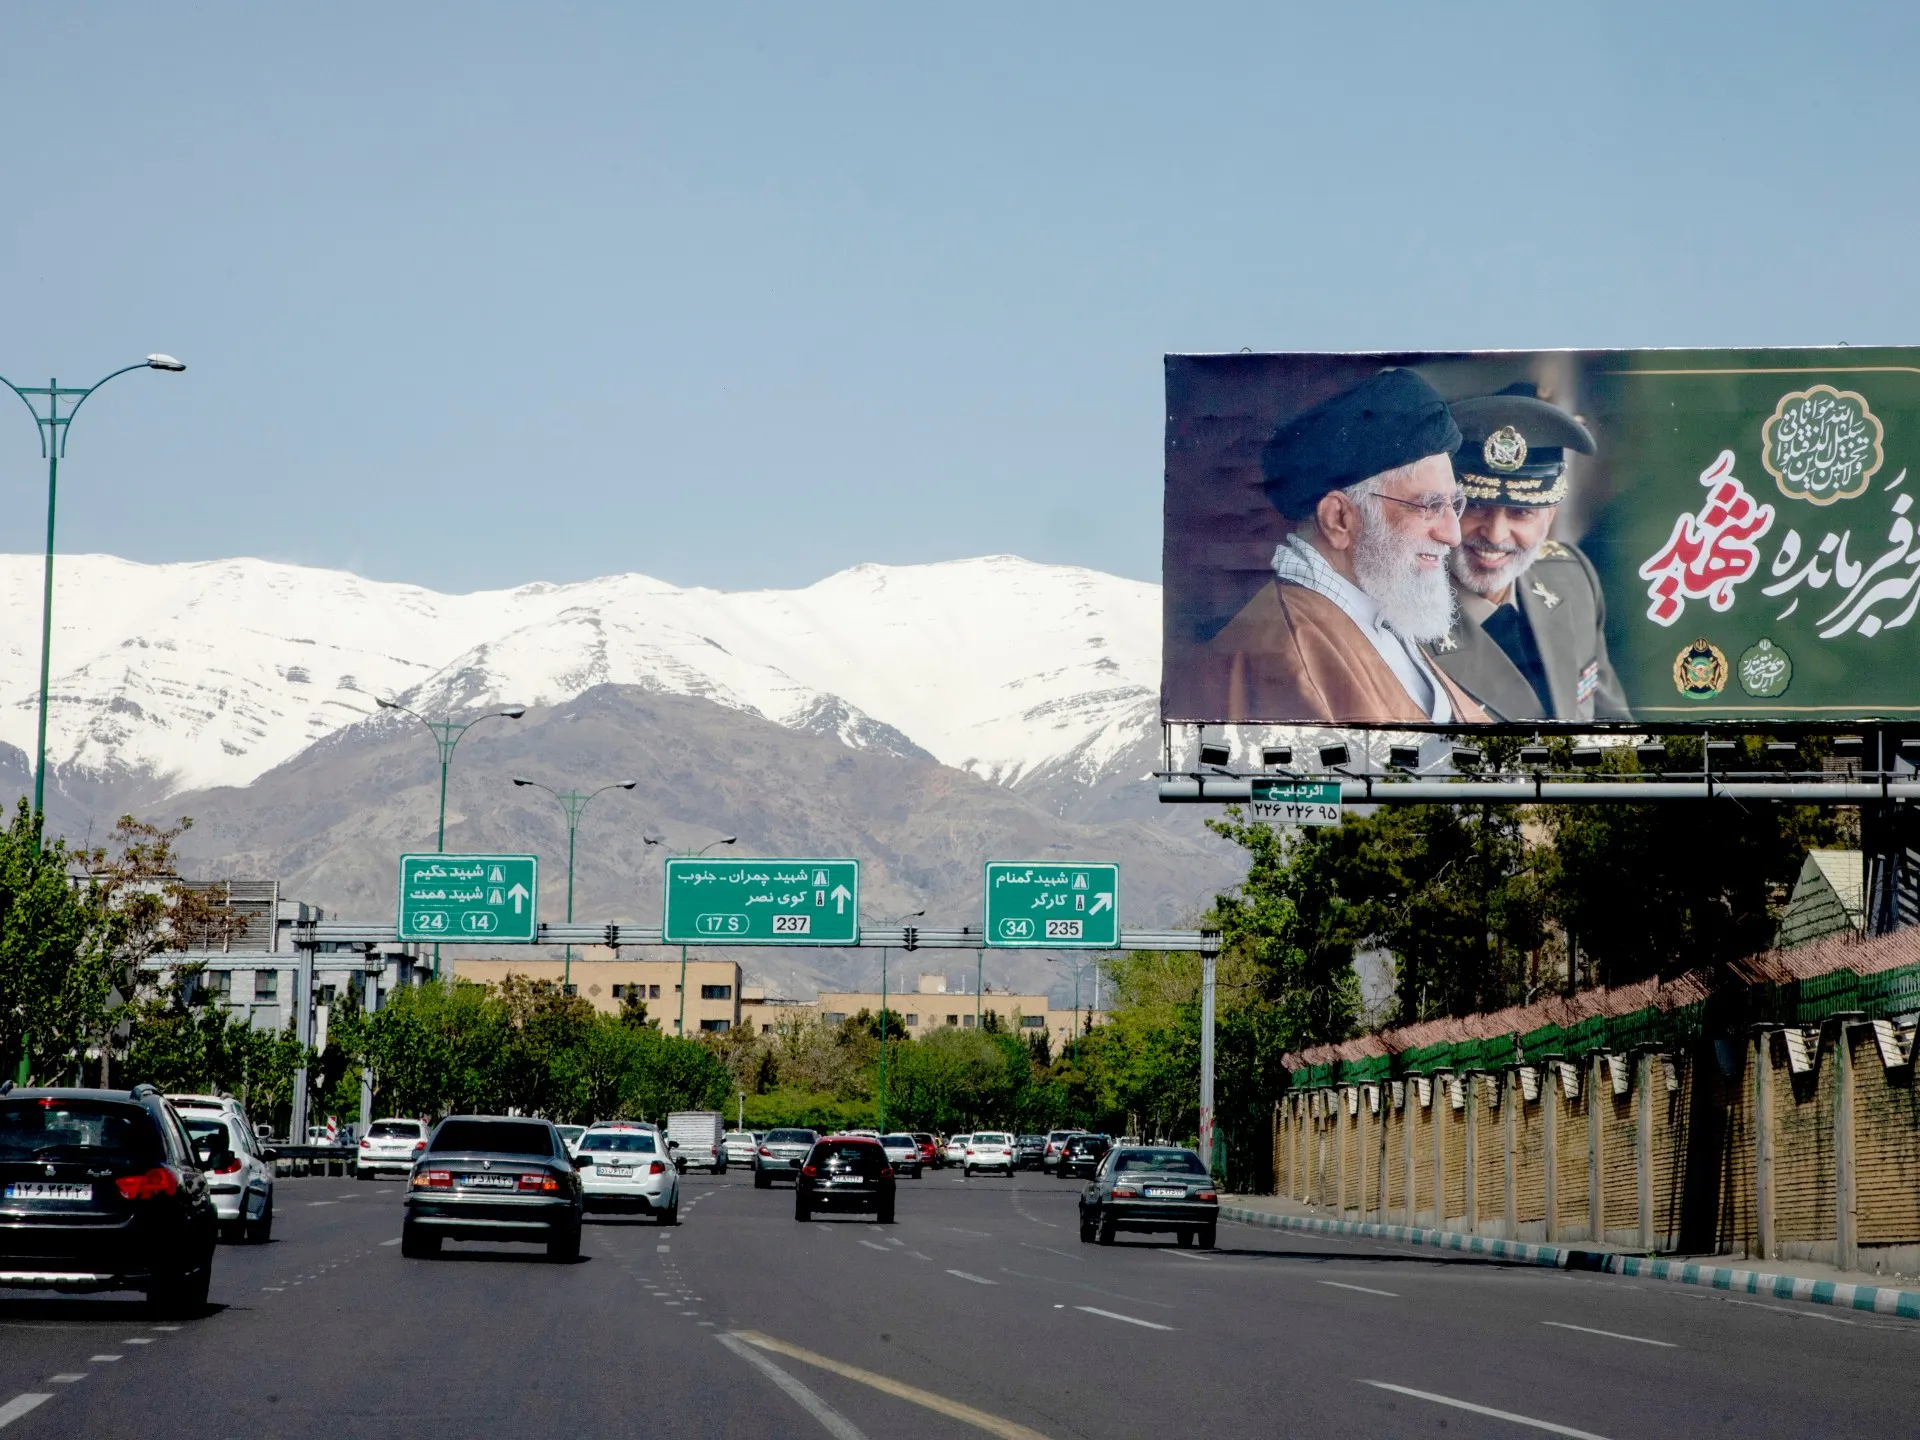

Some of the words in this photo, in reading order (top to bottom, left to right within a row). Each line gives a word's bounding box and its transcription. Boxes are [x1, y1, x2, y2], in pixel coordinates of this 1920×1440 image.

[1640, 450, 1775, 627] شهید
[1255, 803, 1281, 817] ۲۲۶
[1287, 804, 1314, 818] ۲۲۶
[1319, 806, 1337, 819] ۹۵
[413, 865, 447, 883] حکیم
[450, 864, 484, 880] شهید
[677, 871, 716, 885] جنوب
[729, 870, 770, 886] چمران
[773, 869, 808, 883] شهید
[996, 870, 1034, 888] گمنام
[1034, 872, 1068, 886] شهید
[410, 889, 446, 899] همت
[449, 886, 483, 902] شهید
[745, 892, 774, 906] نصر
[777, 891, 807, 907] کوی
[1031, 893, 1068, 910] کارگر
[419, 915, 443, 929] 24
[470, 915, 489, 929] 14
[706, 917, 723, 931] 17
[728, 917, 739, 931] S
[776, 917, 807, 931] 237
[1005, 921, 1027, 936] 34
[1048, 921, 1079, 936] 235
